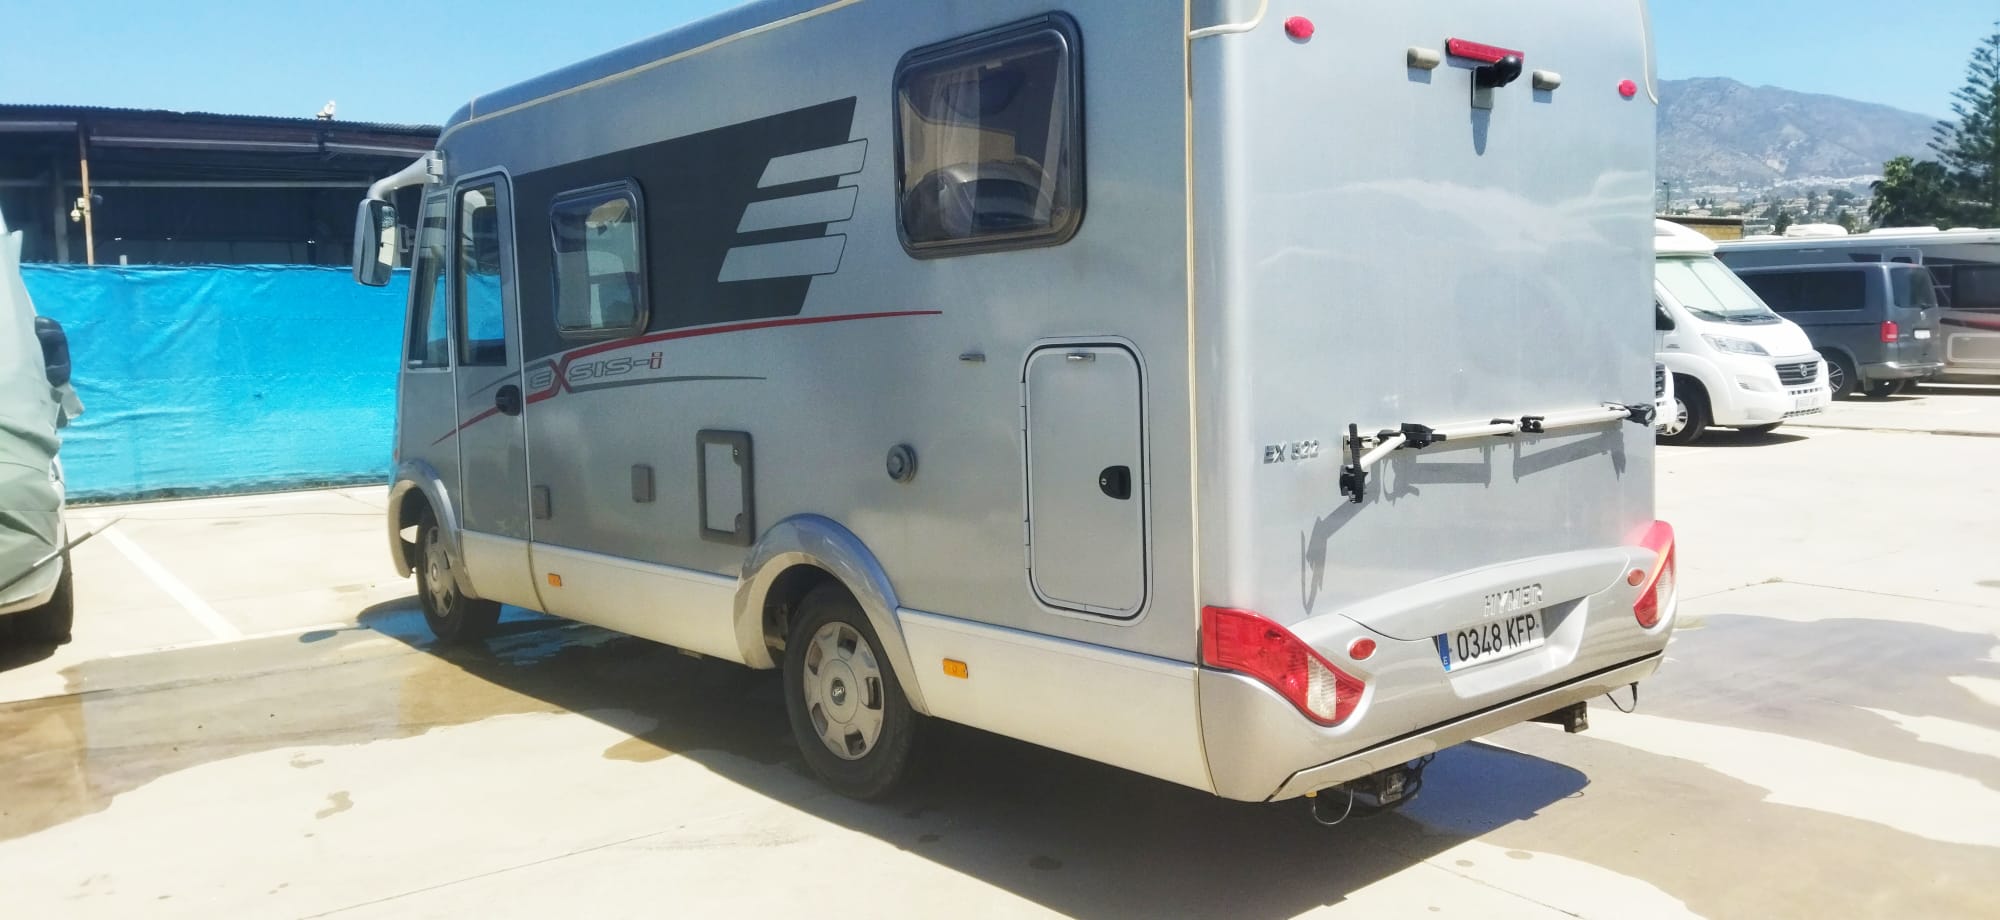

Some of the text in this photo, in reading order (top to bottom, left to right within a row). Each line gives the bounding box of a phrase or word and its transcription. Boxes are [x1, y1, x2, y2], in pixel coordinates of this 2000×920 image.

[1263, 442, 1287, 464] EX
[1483, 583, 1543, 617] HYMER
[1456, 613, 1536, 662] 0348 KFP
